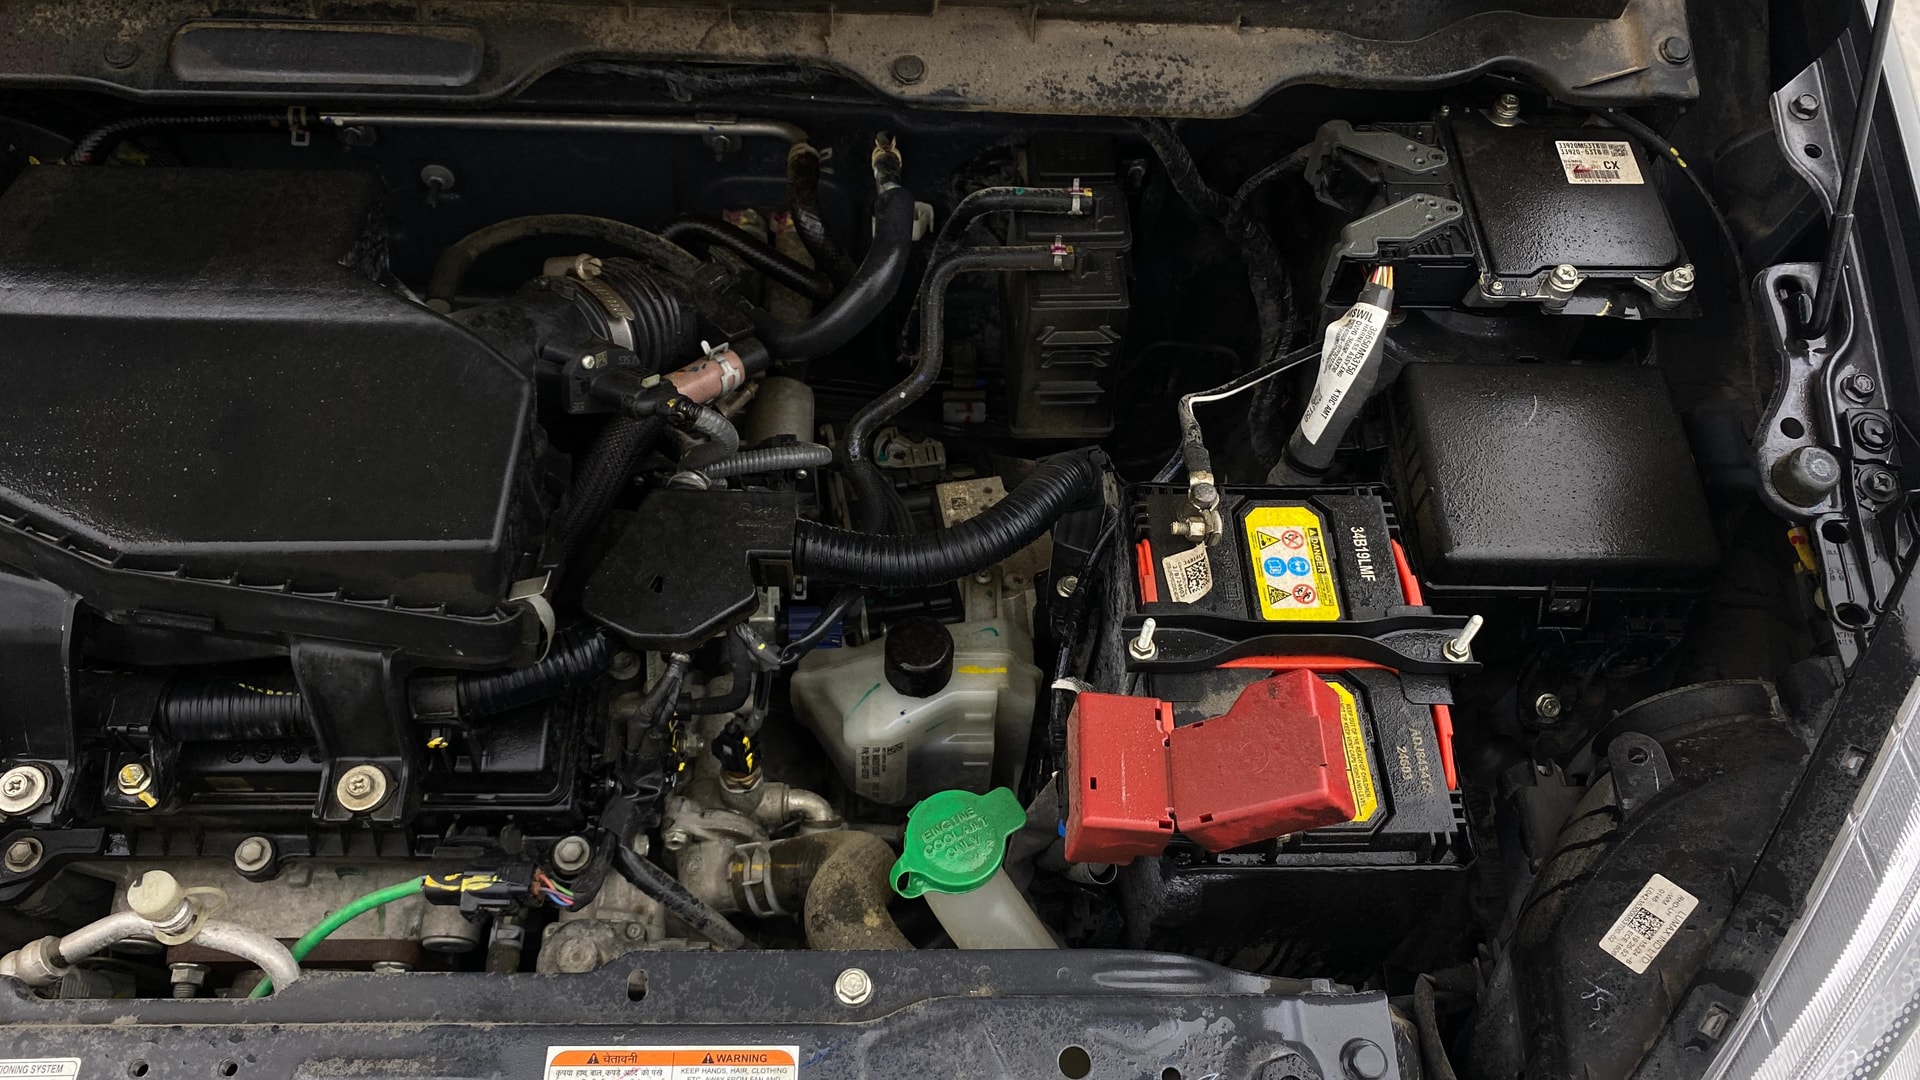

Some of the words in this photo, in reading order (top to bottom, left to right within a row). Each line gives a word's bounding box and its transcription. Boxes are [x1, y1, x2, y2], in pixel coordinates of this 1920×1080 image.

[1604, 160, 1620, 170] CX
[1351, 323, 1369, 351] HARNESS
[1345, 325, 1378, 376] 36650M53T50
[1328, 388, 1343, 406] K10C
[1320, 404, 1333, 420] AMT
[1312, 536, 1326, 574] DANGER
[1350, 527, 1376, 582] 34B19LMF
[1343, 722, 1351, 736] KEEP
[1346, 736, 1354, 749] VENT
[1349, 749, 1357, 764] CAPS
[1355, 746, 1364, 764] REACH
[1396, 745, 1412, 780] 24603
[1352, 764, 1360, 779] TIGHT
[1355, 779, 1363, 791] AND
[921, 806, 977, 844] ENGINE
[924, 816, 989, 859] COOLANT
[945, 834, 980, 860] ONLY
[1665, 894, 1685, 918] RHD-LH
[1662, 909, 1687, 938] LUMAX
[1620, 929, 1634, 944] ECE
[1652, 934, 1667, 951] IND
[1640, 947, 1657, 966] LTD
[604, 1052, 638, 1064] चेतावनी
[716, 1054, 768, 1063] WARNING
[30, 1064, 64, 1074] SYSTEM
